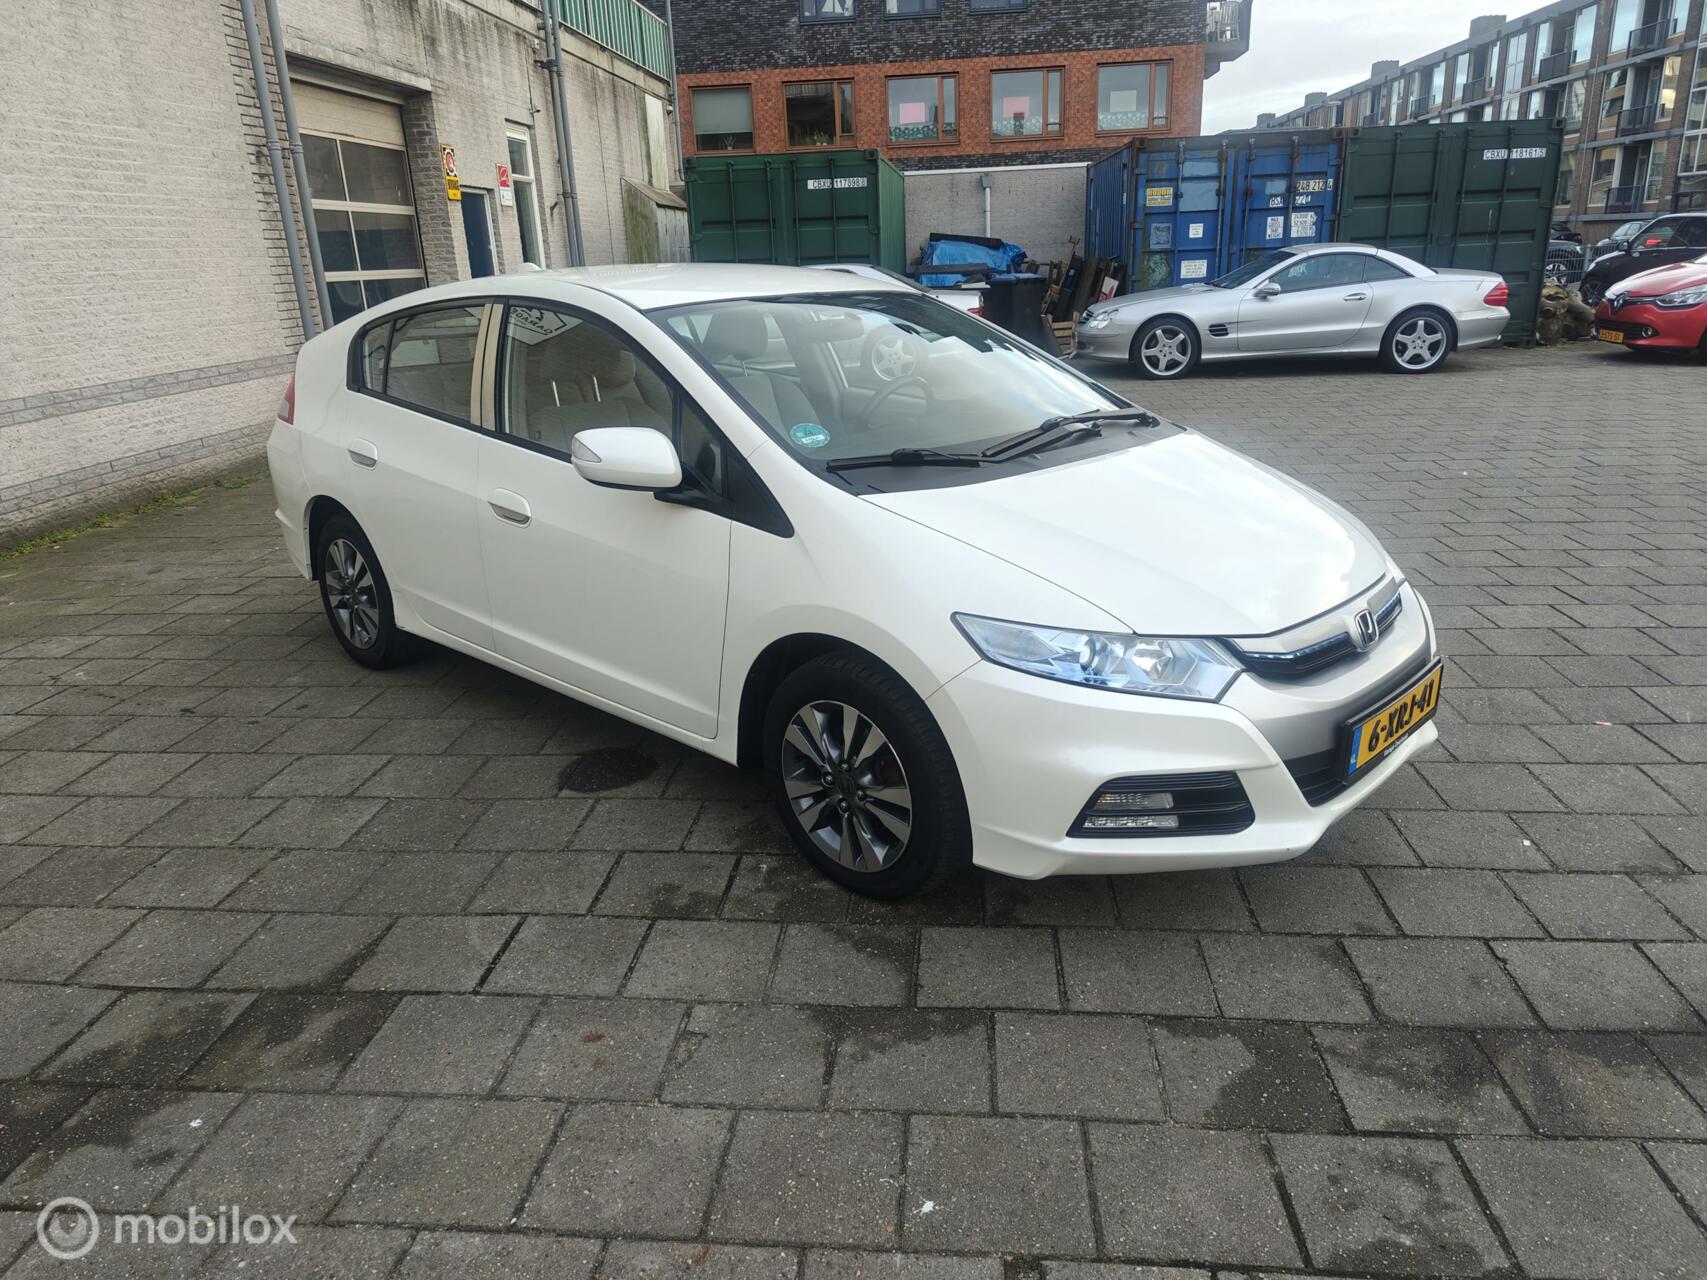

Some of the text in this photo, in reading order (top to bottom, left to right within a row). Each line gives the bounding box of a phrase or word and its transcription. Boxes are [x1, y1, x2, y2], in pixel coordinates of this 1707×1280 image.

[1484, 149, 1507, 159] CBXU
[812, 180, 831, 189] CBXU
[1368, 679, 1435, 752] 6-XRJ-41
